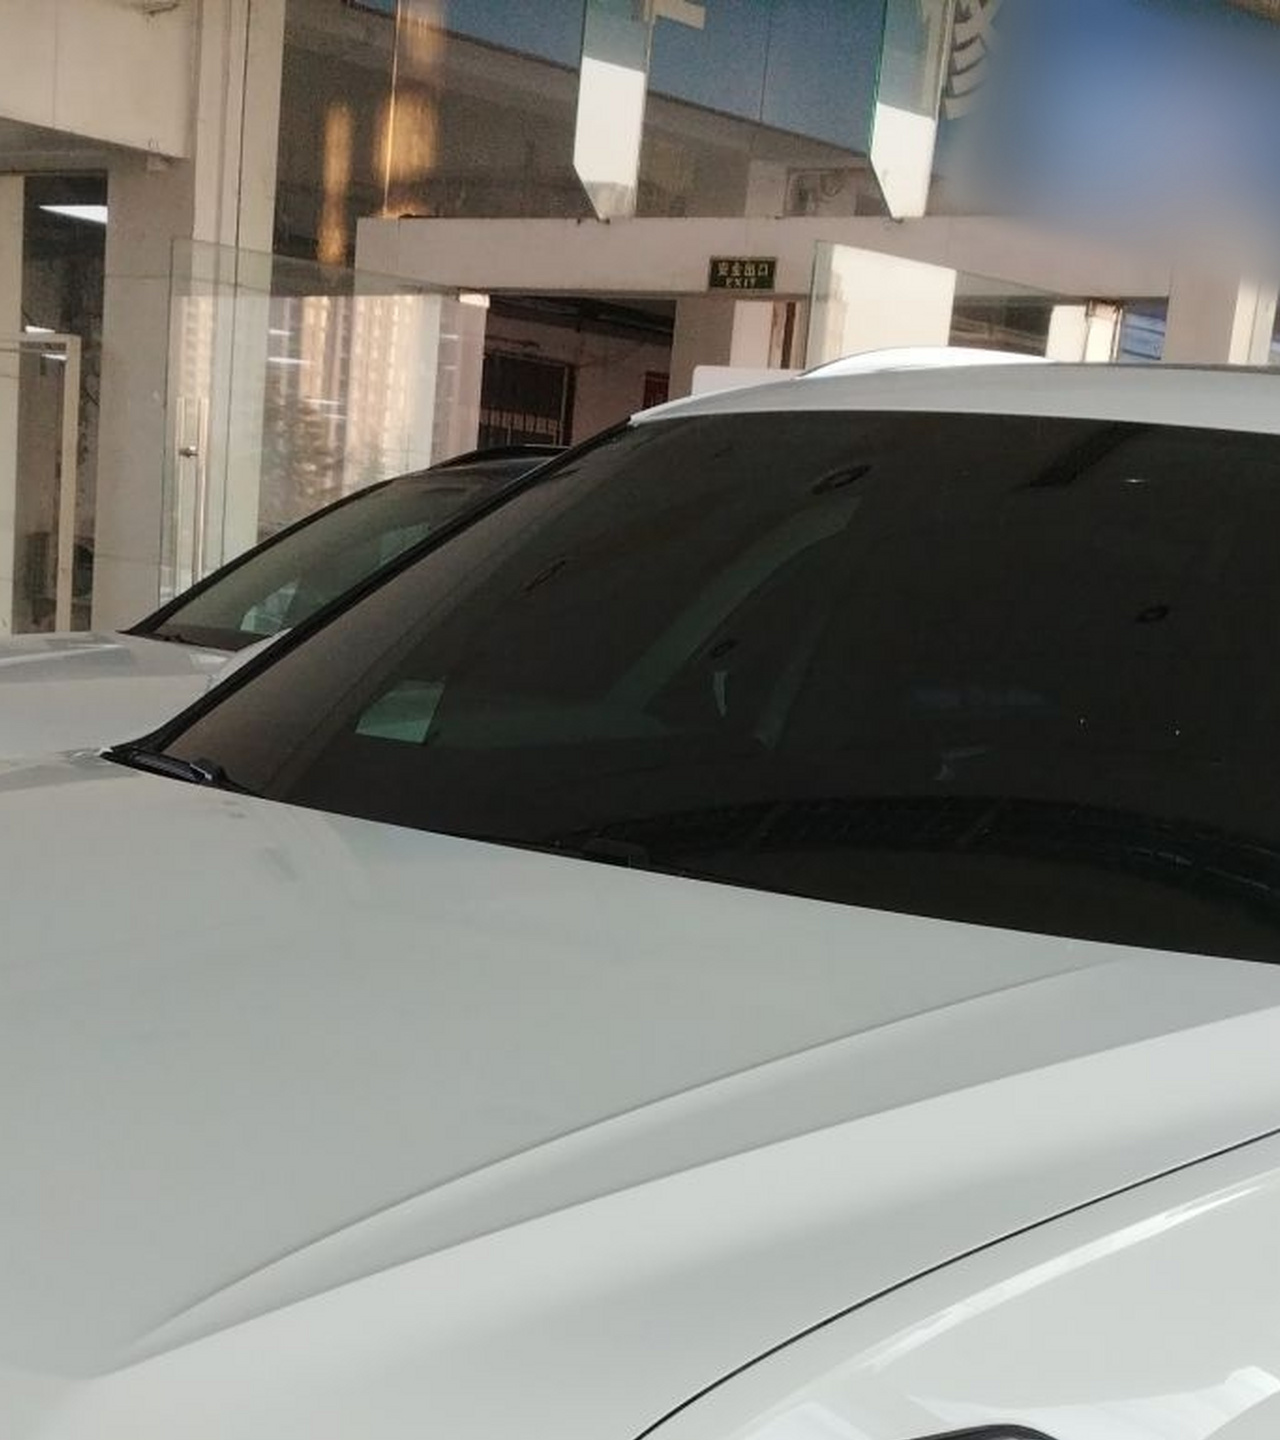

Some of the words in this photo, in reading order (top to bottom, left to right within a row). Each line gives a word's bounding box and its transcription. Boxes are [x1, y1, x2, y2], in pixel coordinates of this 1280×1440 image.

[718, 262, 769, 277] 安全出口
[725, 277, 757, 288] EXIT
